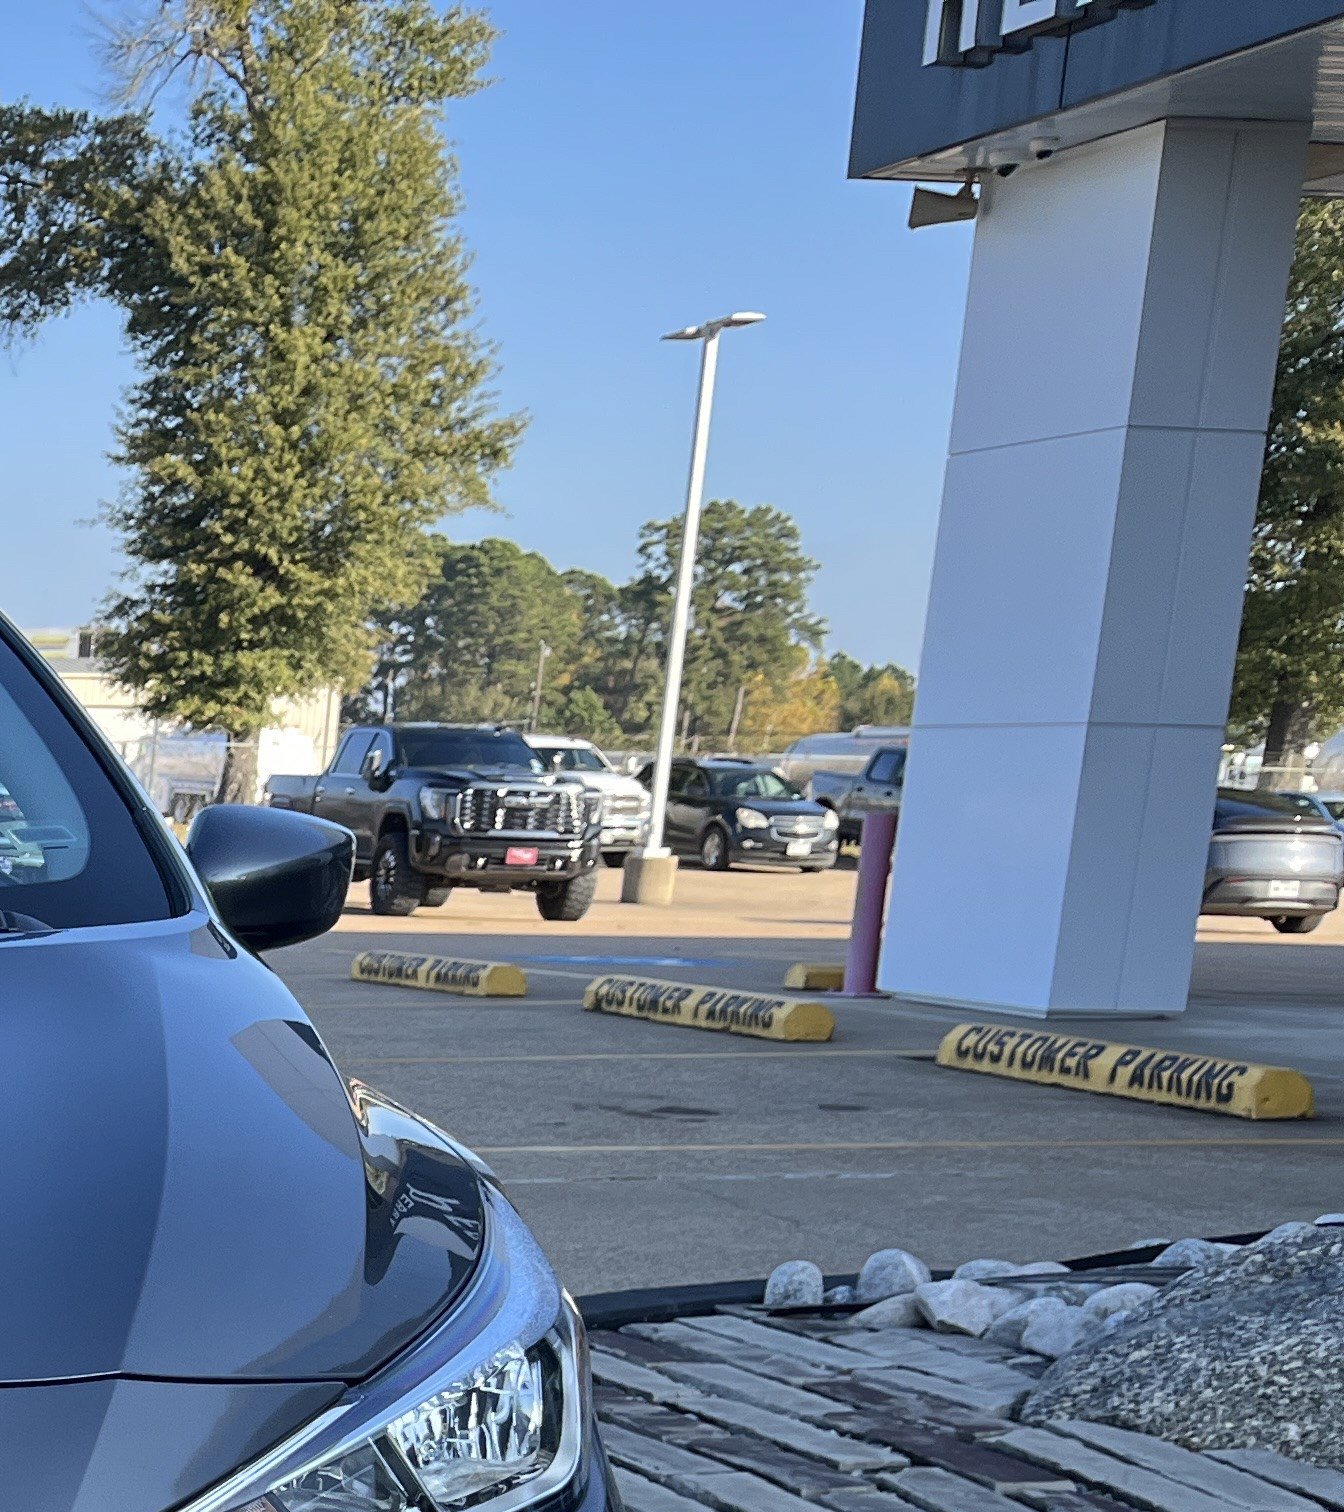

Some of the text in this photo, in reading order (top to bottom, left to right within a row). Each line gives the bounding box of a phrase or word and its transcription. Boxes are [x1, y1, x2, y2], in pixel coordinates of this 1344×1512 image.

[595, 977, 785, 1029] CUSTOMER PARKING
[956, 1026, 1248, 1103] CUSTOMER PARKING
